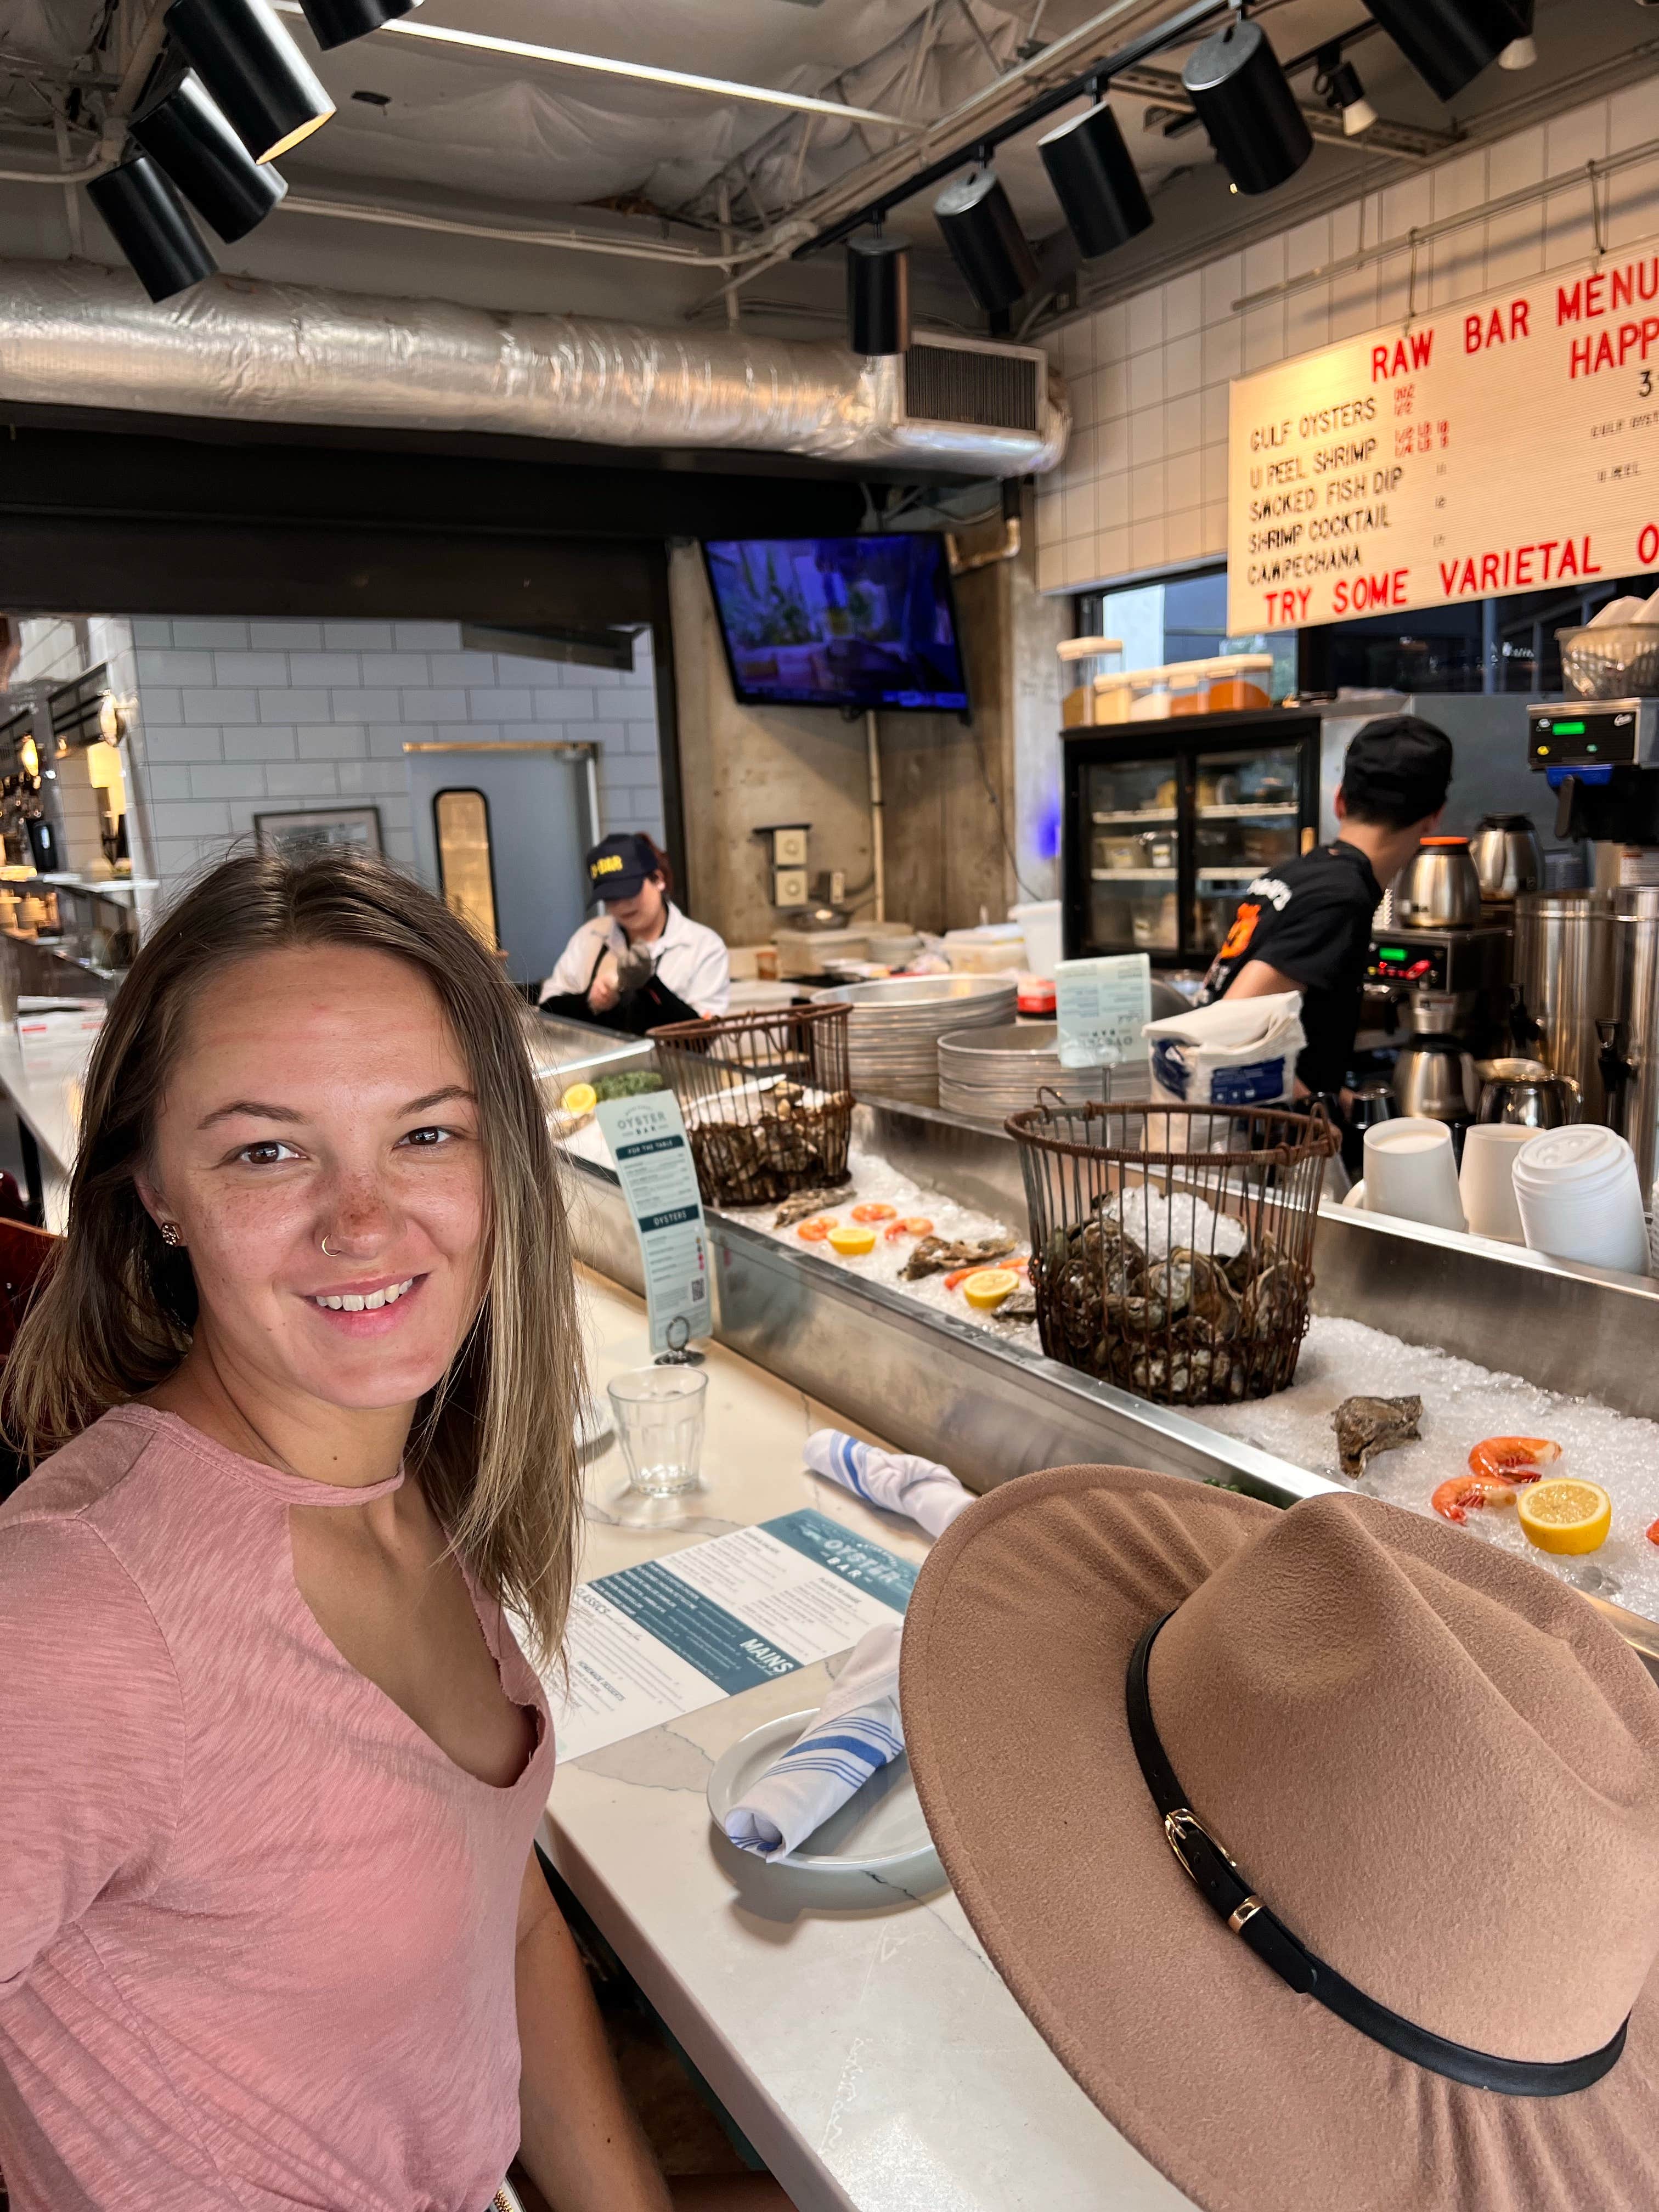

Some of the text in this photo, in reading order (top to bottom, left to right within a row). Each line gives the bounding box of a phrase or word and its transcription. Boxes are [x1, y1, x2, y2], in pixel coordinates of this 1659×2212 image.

[1373, 257, 1659, 382] RAW BAR MENU
[1569, 317, 1659, 379] HAPP
[1250, 396, 1377, 452] GULF OYSTERS
[1250, 437, 1379, 490] U PEEL SHRIMP
[1249, 488, 1317, 523] SMOKED
[1327, 473, 1368, 506] FISH
[1373, 466, 1404, 494] DIP
[1248, 523, 1304, 554] SHRIMP
[1308, 503, 1392, 541] COCKTAIL
[1247, 544, 1362, 586] CAMPECHANA
[1263, 524, 1659, 625] TRY SOME VARIETAL O
[617, 1111, 666, 1130] OYSTER
[653, 1210, 687, 1226] OYSTERS
[823, 1540, 900, 1583] OYSTER
[826, 1557, 862, 1579] BAR
[740, 1638, 794, 1673] MAINS
